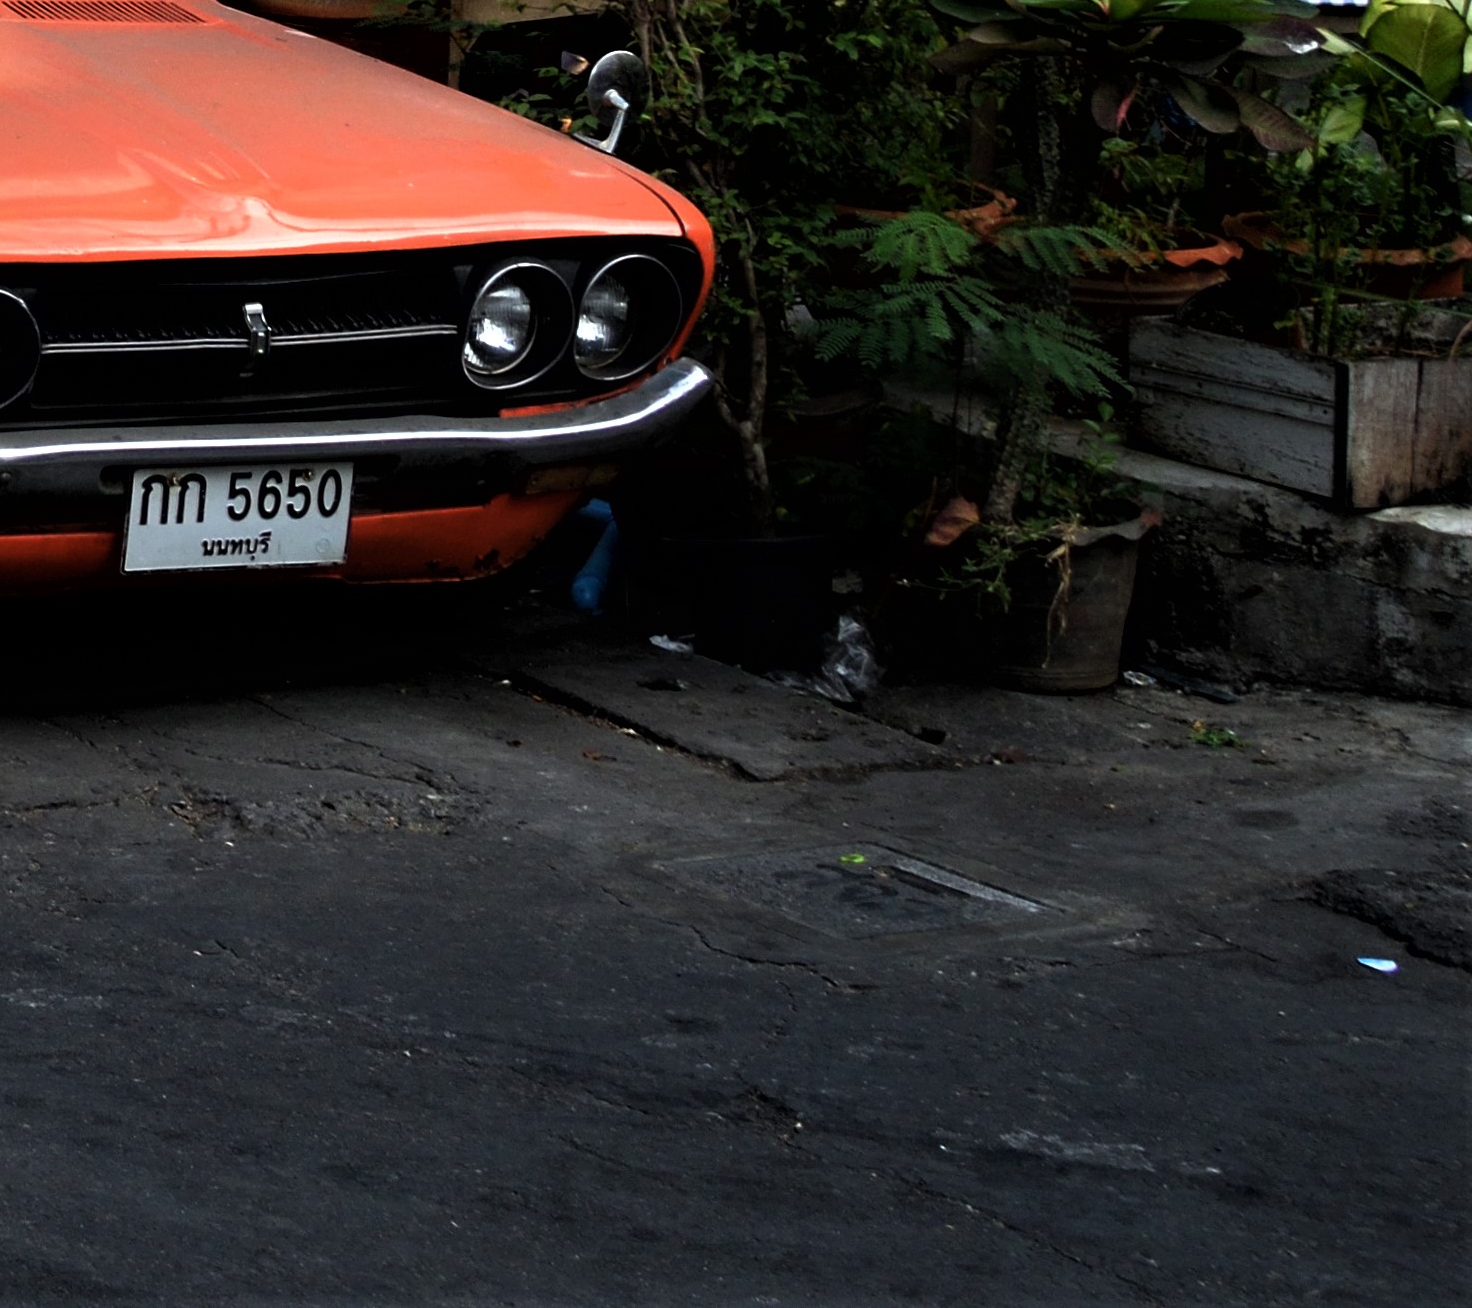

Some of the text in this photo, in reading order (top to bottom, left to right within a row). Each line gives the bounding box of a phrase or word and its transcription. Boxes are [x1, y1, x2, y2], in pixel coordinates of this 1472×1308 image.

[139, 468, 343, 526] กก 5650
[201, 530, 273, 561] นนทบุรี
